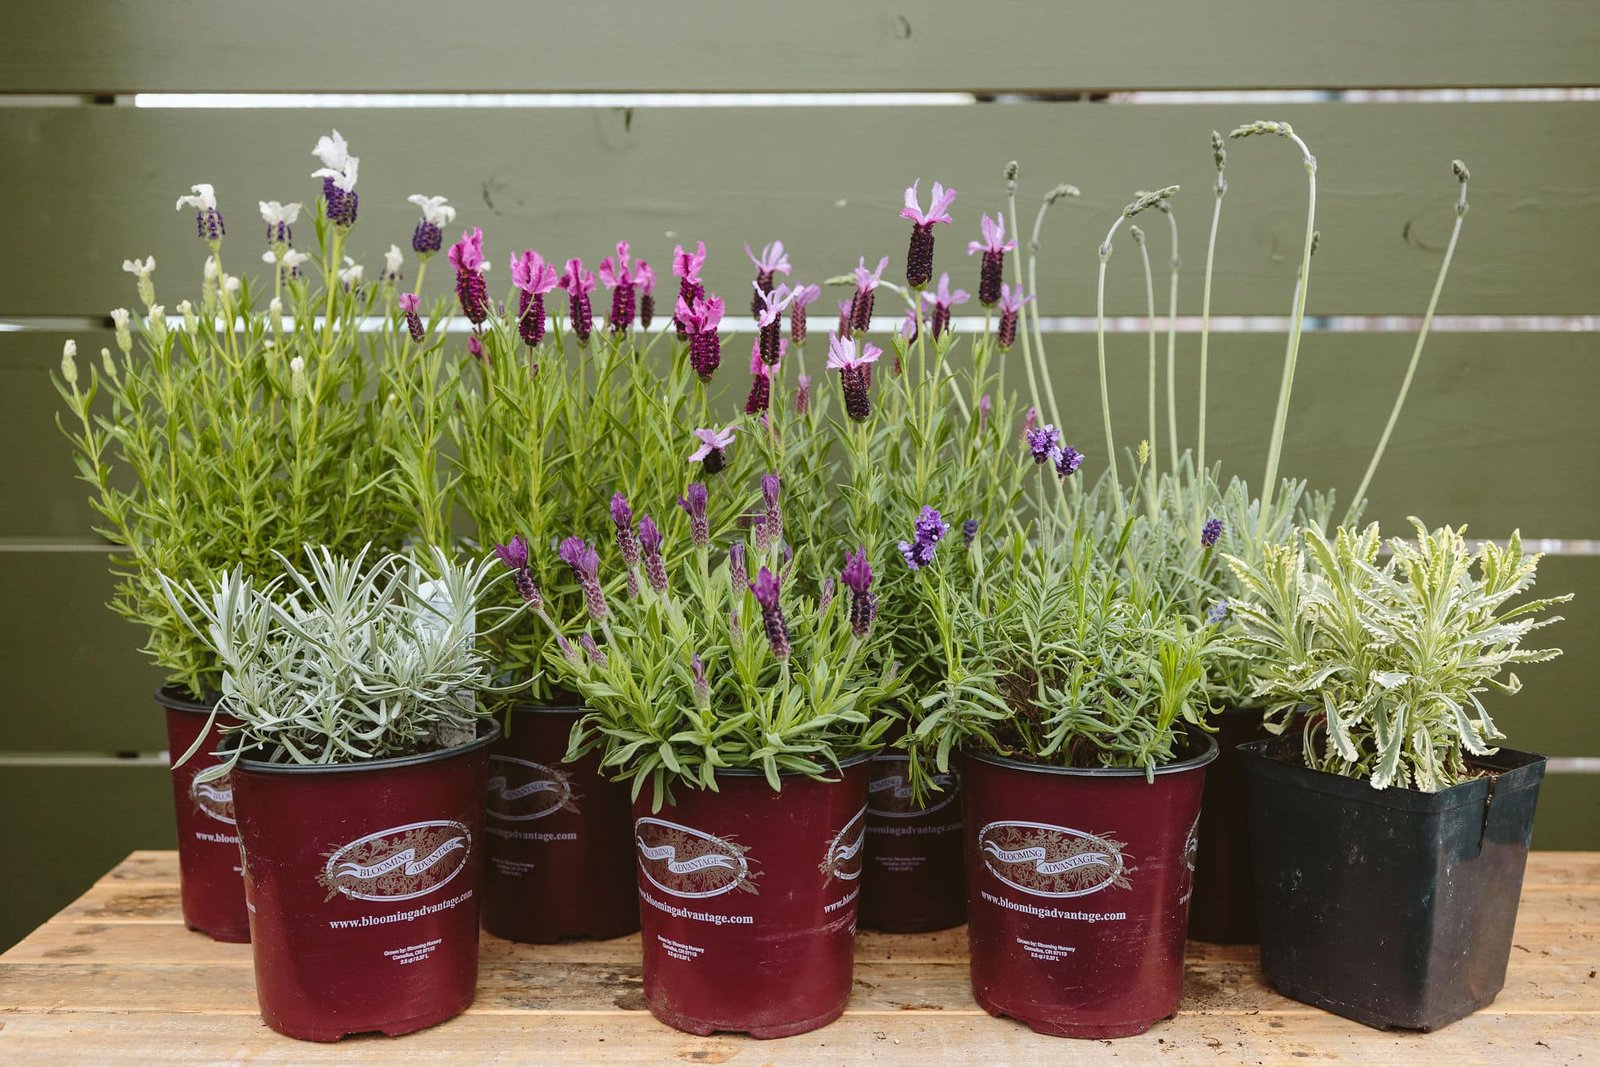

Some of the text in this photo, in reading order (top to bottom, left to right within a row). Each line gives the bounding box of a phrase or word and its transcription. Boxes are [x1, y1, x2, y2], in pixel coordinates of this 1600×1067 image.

[360, 851, 412, 877] BLOOMING
[412, 840, 457, 871] ADVANTAGE
[674, 856, 720, 872] ADVANTAGE
[998, 849, 1096, 873] BLOOMING ADVANTAGE
[329, 889, 473, 929] www.bloomingadvantage.com
[980, 890, 1127, 923] www.bloomingadvantage.com
